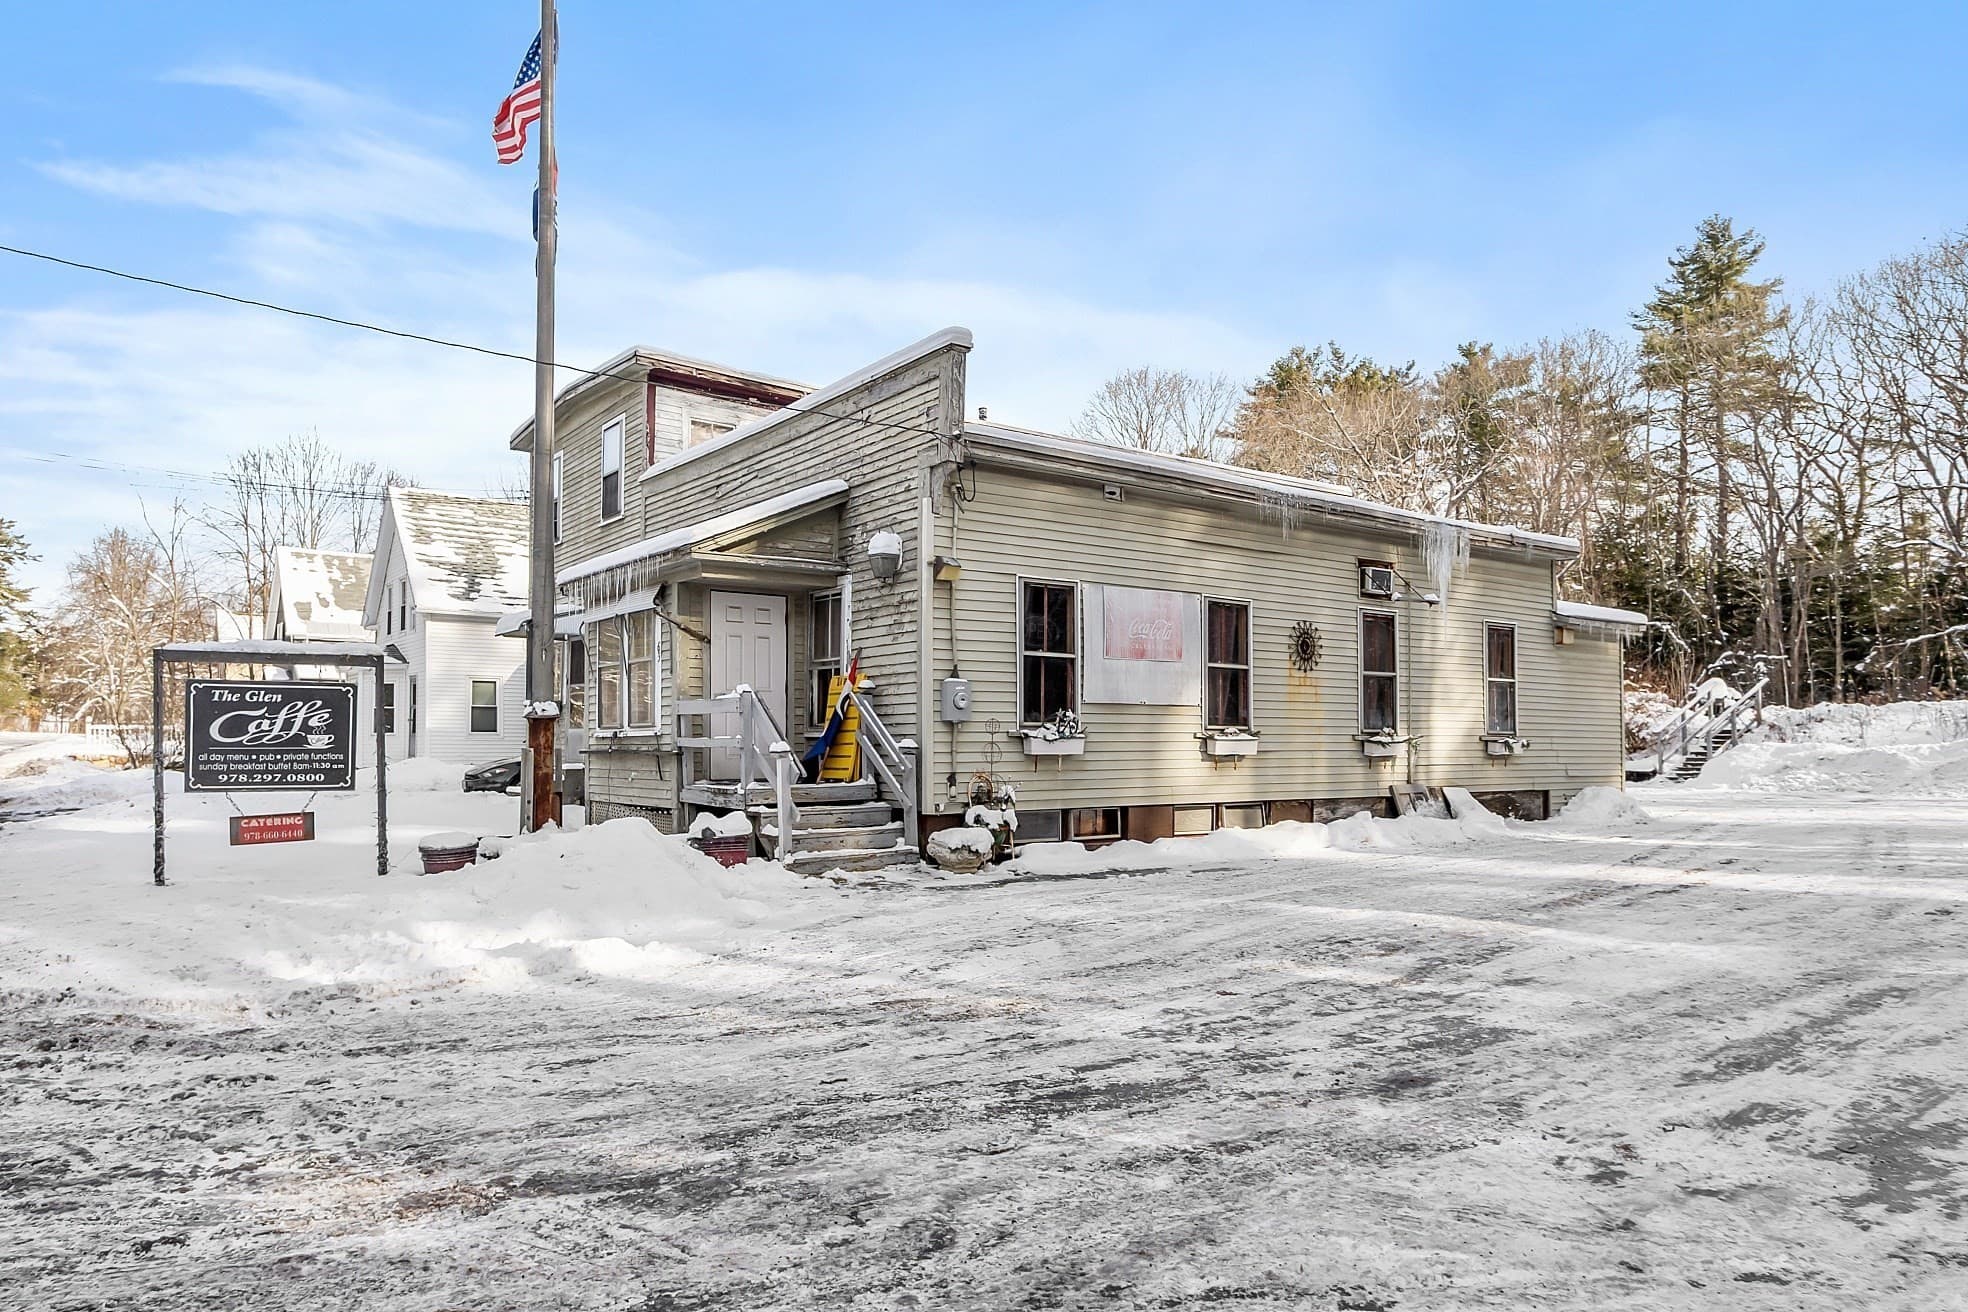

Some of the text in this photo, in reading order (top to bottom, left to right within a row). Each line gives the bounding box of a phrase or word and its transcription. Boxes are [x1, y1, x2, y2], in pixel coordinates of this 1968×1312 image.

[211, 689, 282, 703] The Glen
[209, 700, 333, 745] Caffe
[198, 752, 208, 761] all
[209, 752, 225, 762] day
[259, 752, 275, 762] pub
[283, 752, 309, 762] private
[311, 752, 344, 760] functions
[199, 762, 228, 772] sunday
[229, 762, 266, 770] breakfast
[268, 762, 291, 770] buffet
[218, 773, 325, 783] 978.297.0800
